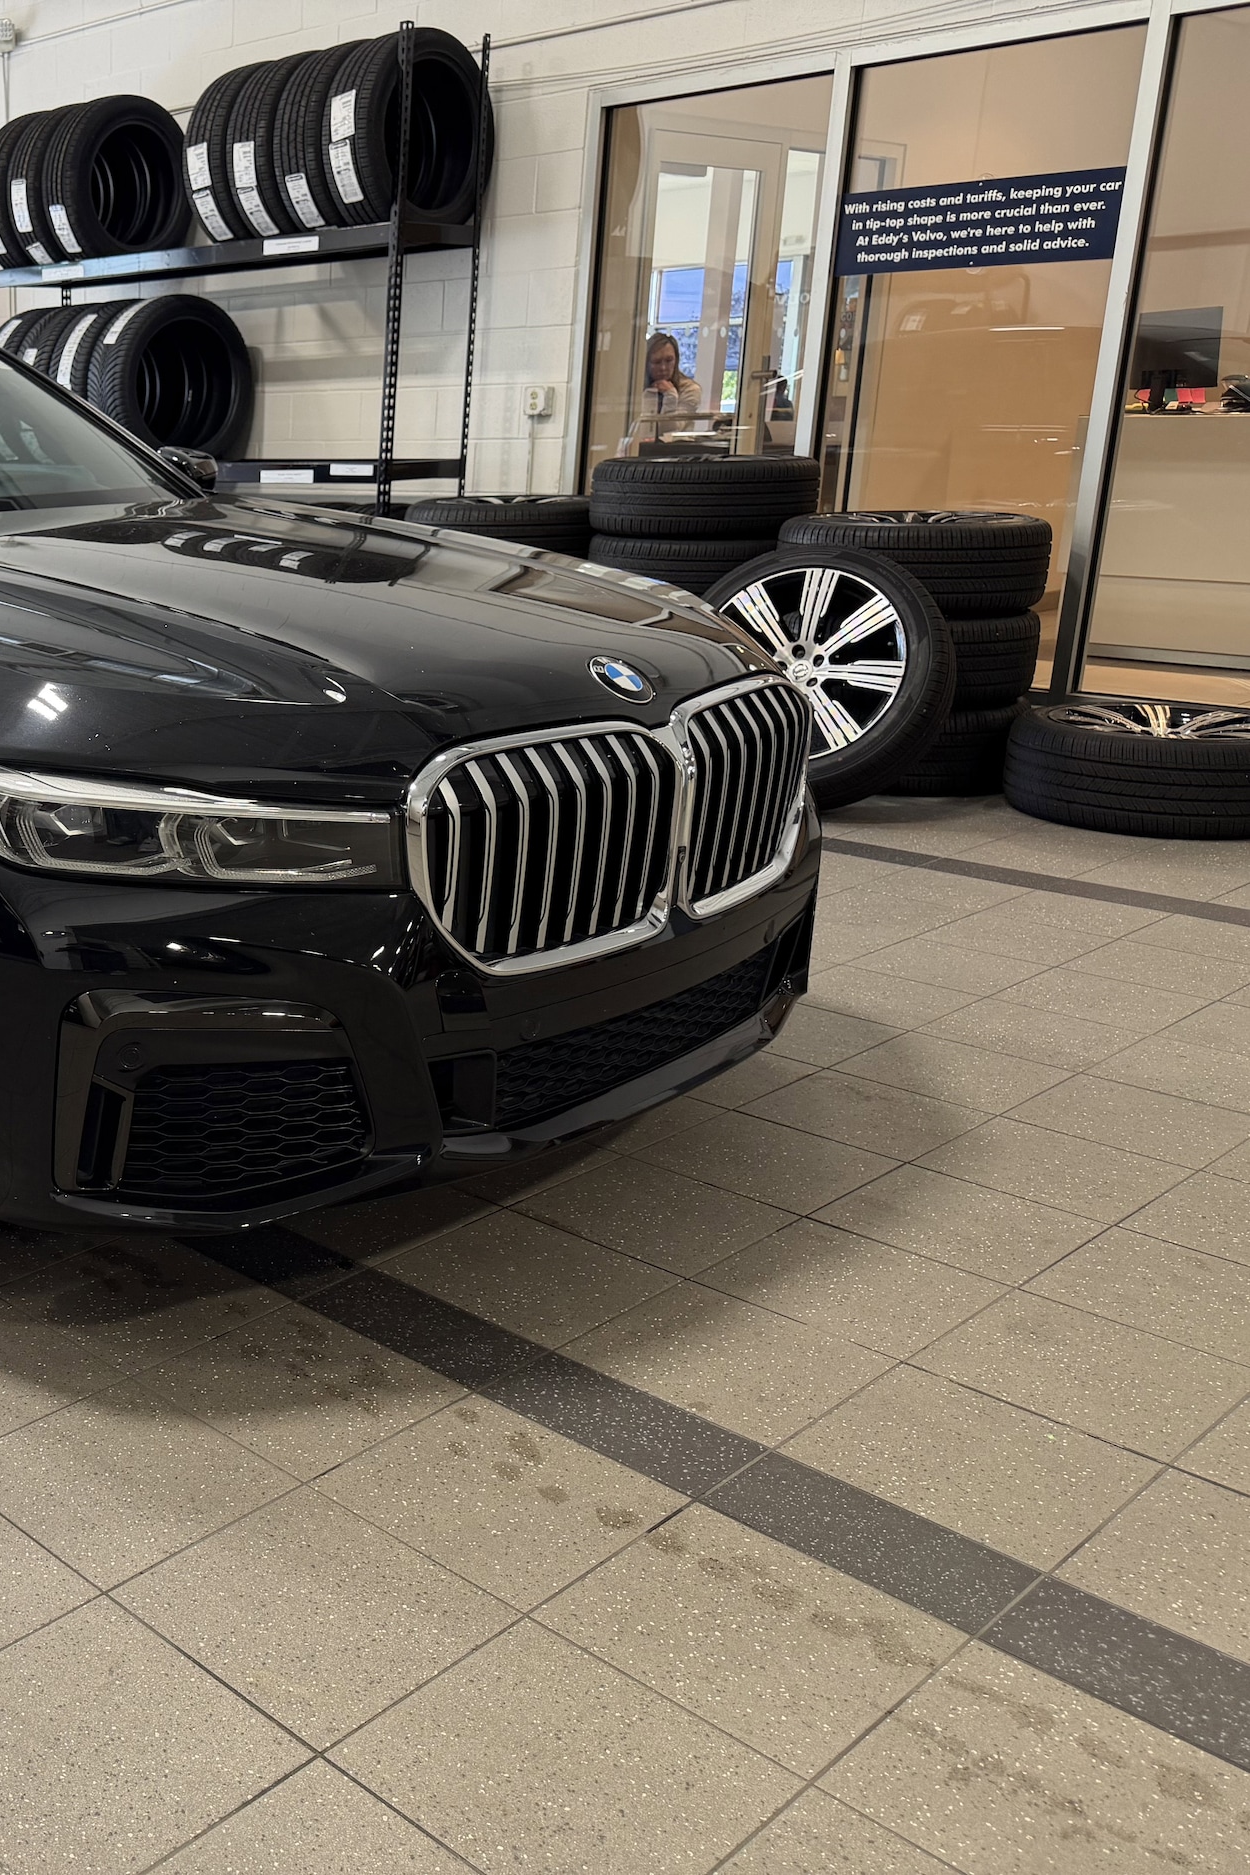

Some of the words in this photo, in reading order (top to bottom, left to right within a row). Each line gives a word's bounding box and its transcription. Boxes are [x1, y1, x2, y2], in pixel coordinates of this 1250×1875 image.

[844, 202, 869, 215] With
[872, 200, 905, 213] rising
[908, 197, 936, 209] costs
[939, 192, 963, 206] and
[966, 189, 1006, 204] tariffs,
[1010, 185, 1062, 200] keeping
[1066, 182, 1096, 197] your
[1100, 180, 1122, 191] car
[852, 220, 863, 230] in
[866, 216, 904, 231] tip-top
[907, 214, 943, 227] shape
[946, 211, 956, 222] is
[959, 209, 991, 221] more
[994, 203, 1036, 218] crucial
[1040, 202, 1070, 214] than
[1073, 200, 1106, 212] ever.
[856, 235, 869, 246] At
[871, 232, 909, 246] Eddy's
[912, 229, 947, 241] Volvo,
[950, 226, 983, 239] we're
[986, 225, 1015, 236] here
[1018, 223, 1031, 233] to
[1034, 220, 1064, 234] help
[1067, 217, 1096, 230] with
[856, 248, 909, 262] thorough
[911, 244, 978, 260] inspections
[981, 241, 1006, 254] and
[1008, 238, 1040, 251] solid
[1043, 236, 1090, 250] advice.
